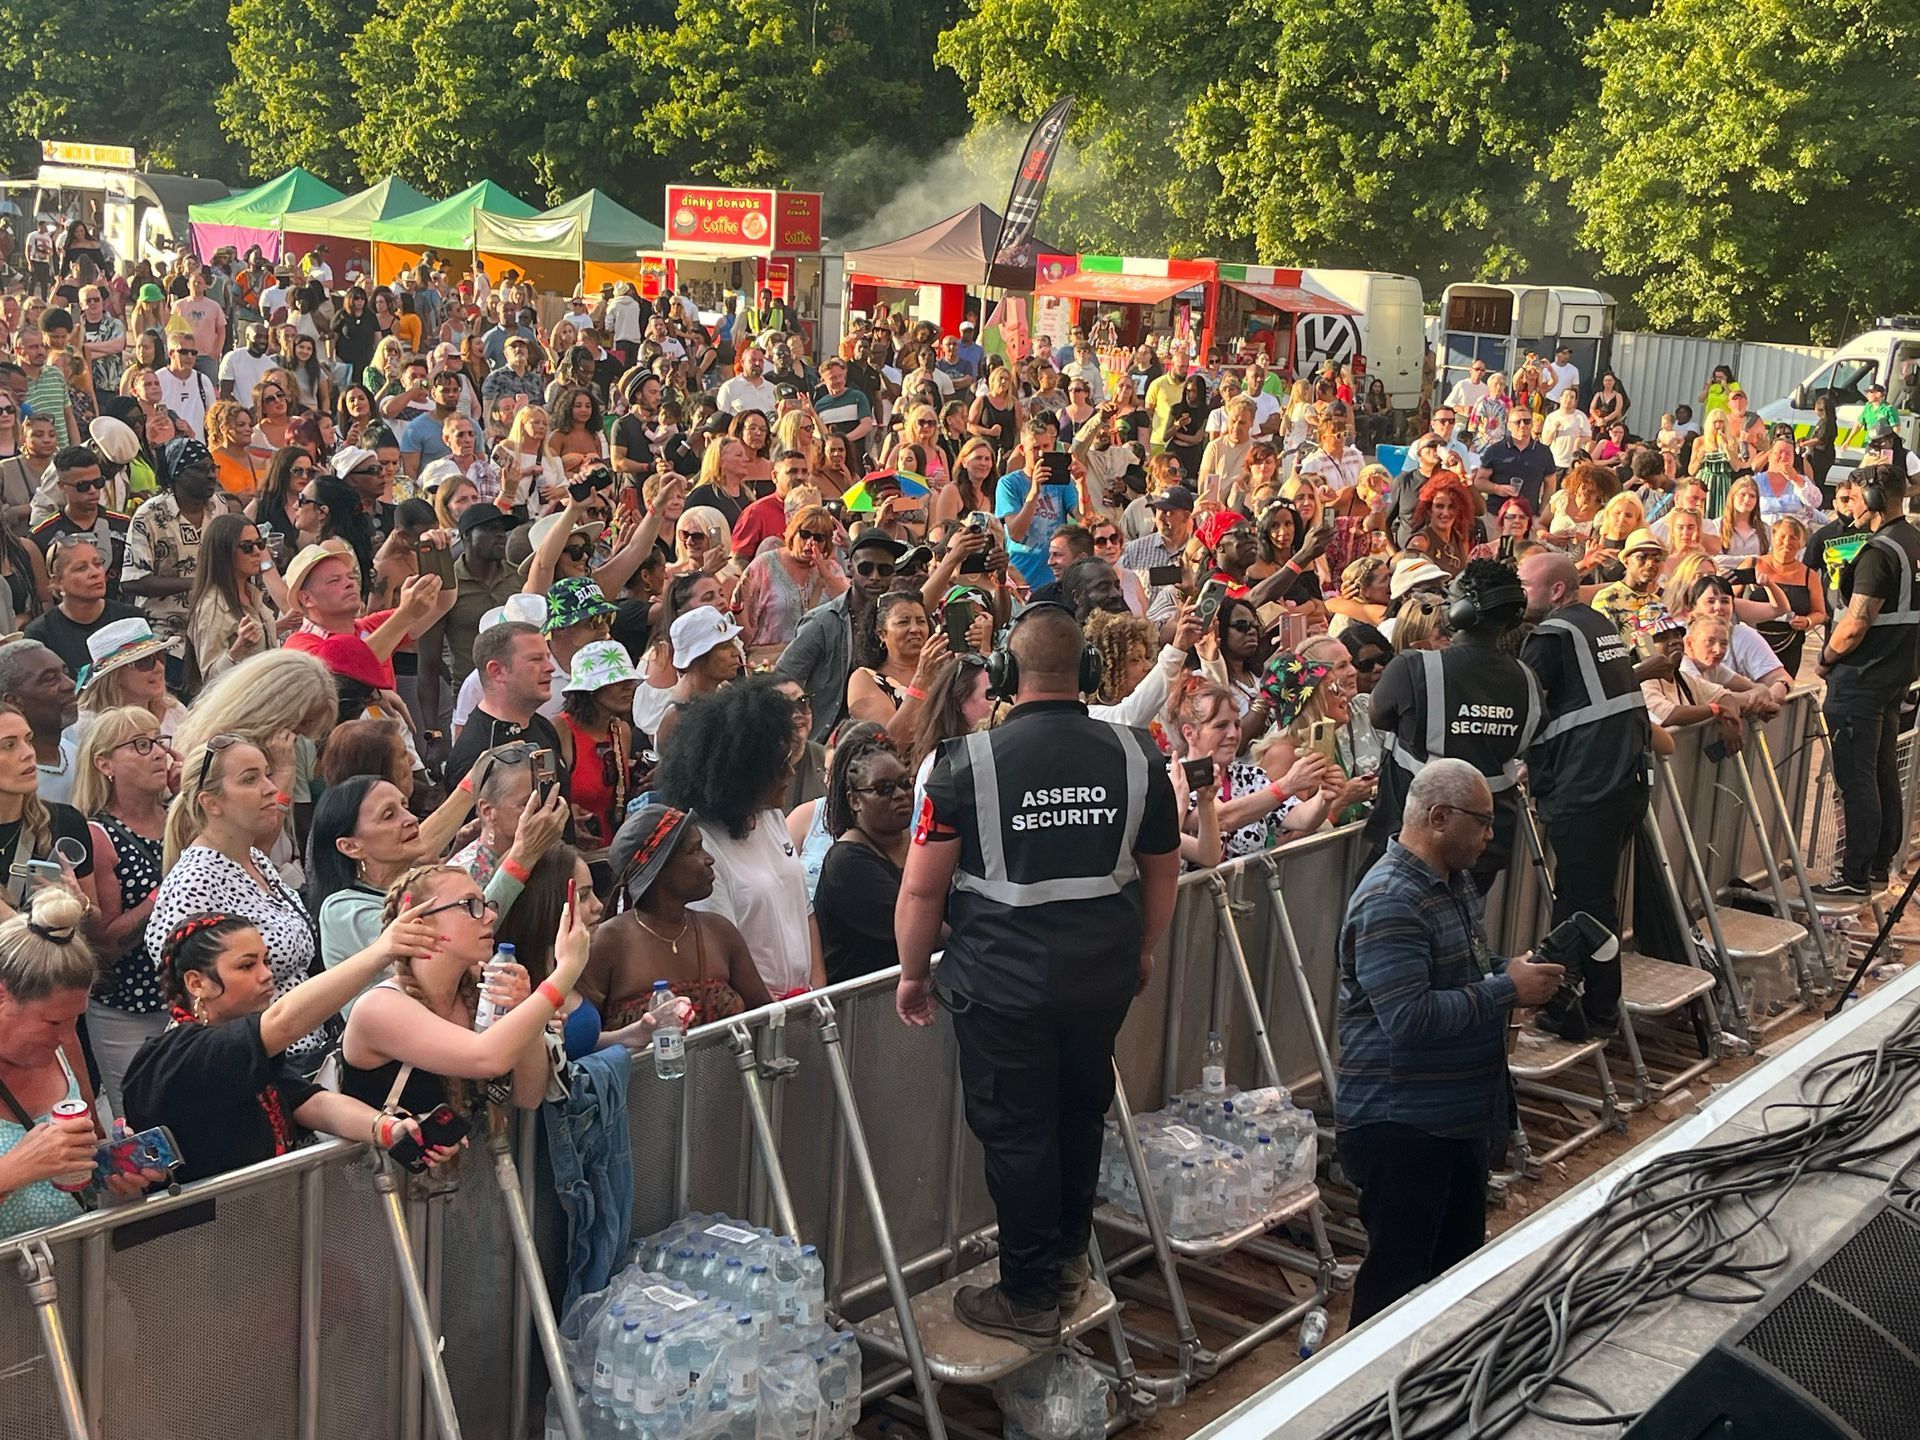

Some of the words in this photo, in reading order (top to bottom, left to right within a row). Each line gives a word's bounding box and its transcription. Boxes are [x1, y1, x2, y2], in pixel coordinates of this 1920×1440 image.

[681, 194, 713, 211] dinky
[702, 215, 739, 235] Coffee
[1458, 703, 1514, 719] ASSERO
[1450, 720, 1519, 737] SECURITY
[1021, 786, 1107, 808] ASSERO
[1011, 808, 1118, 831] SECURITY
